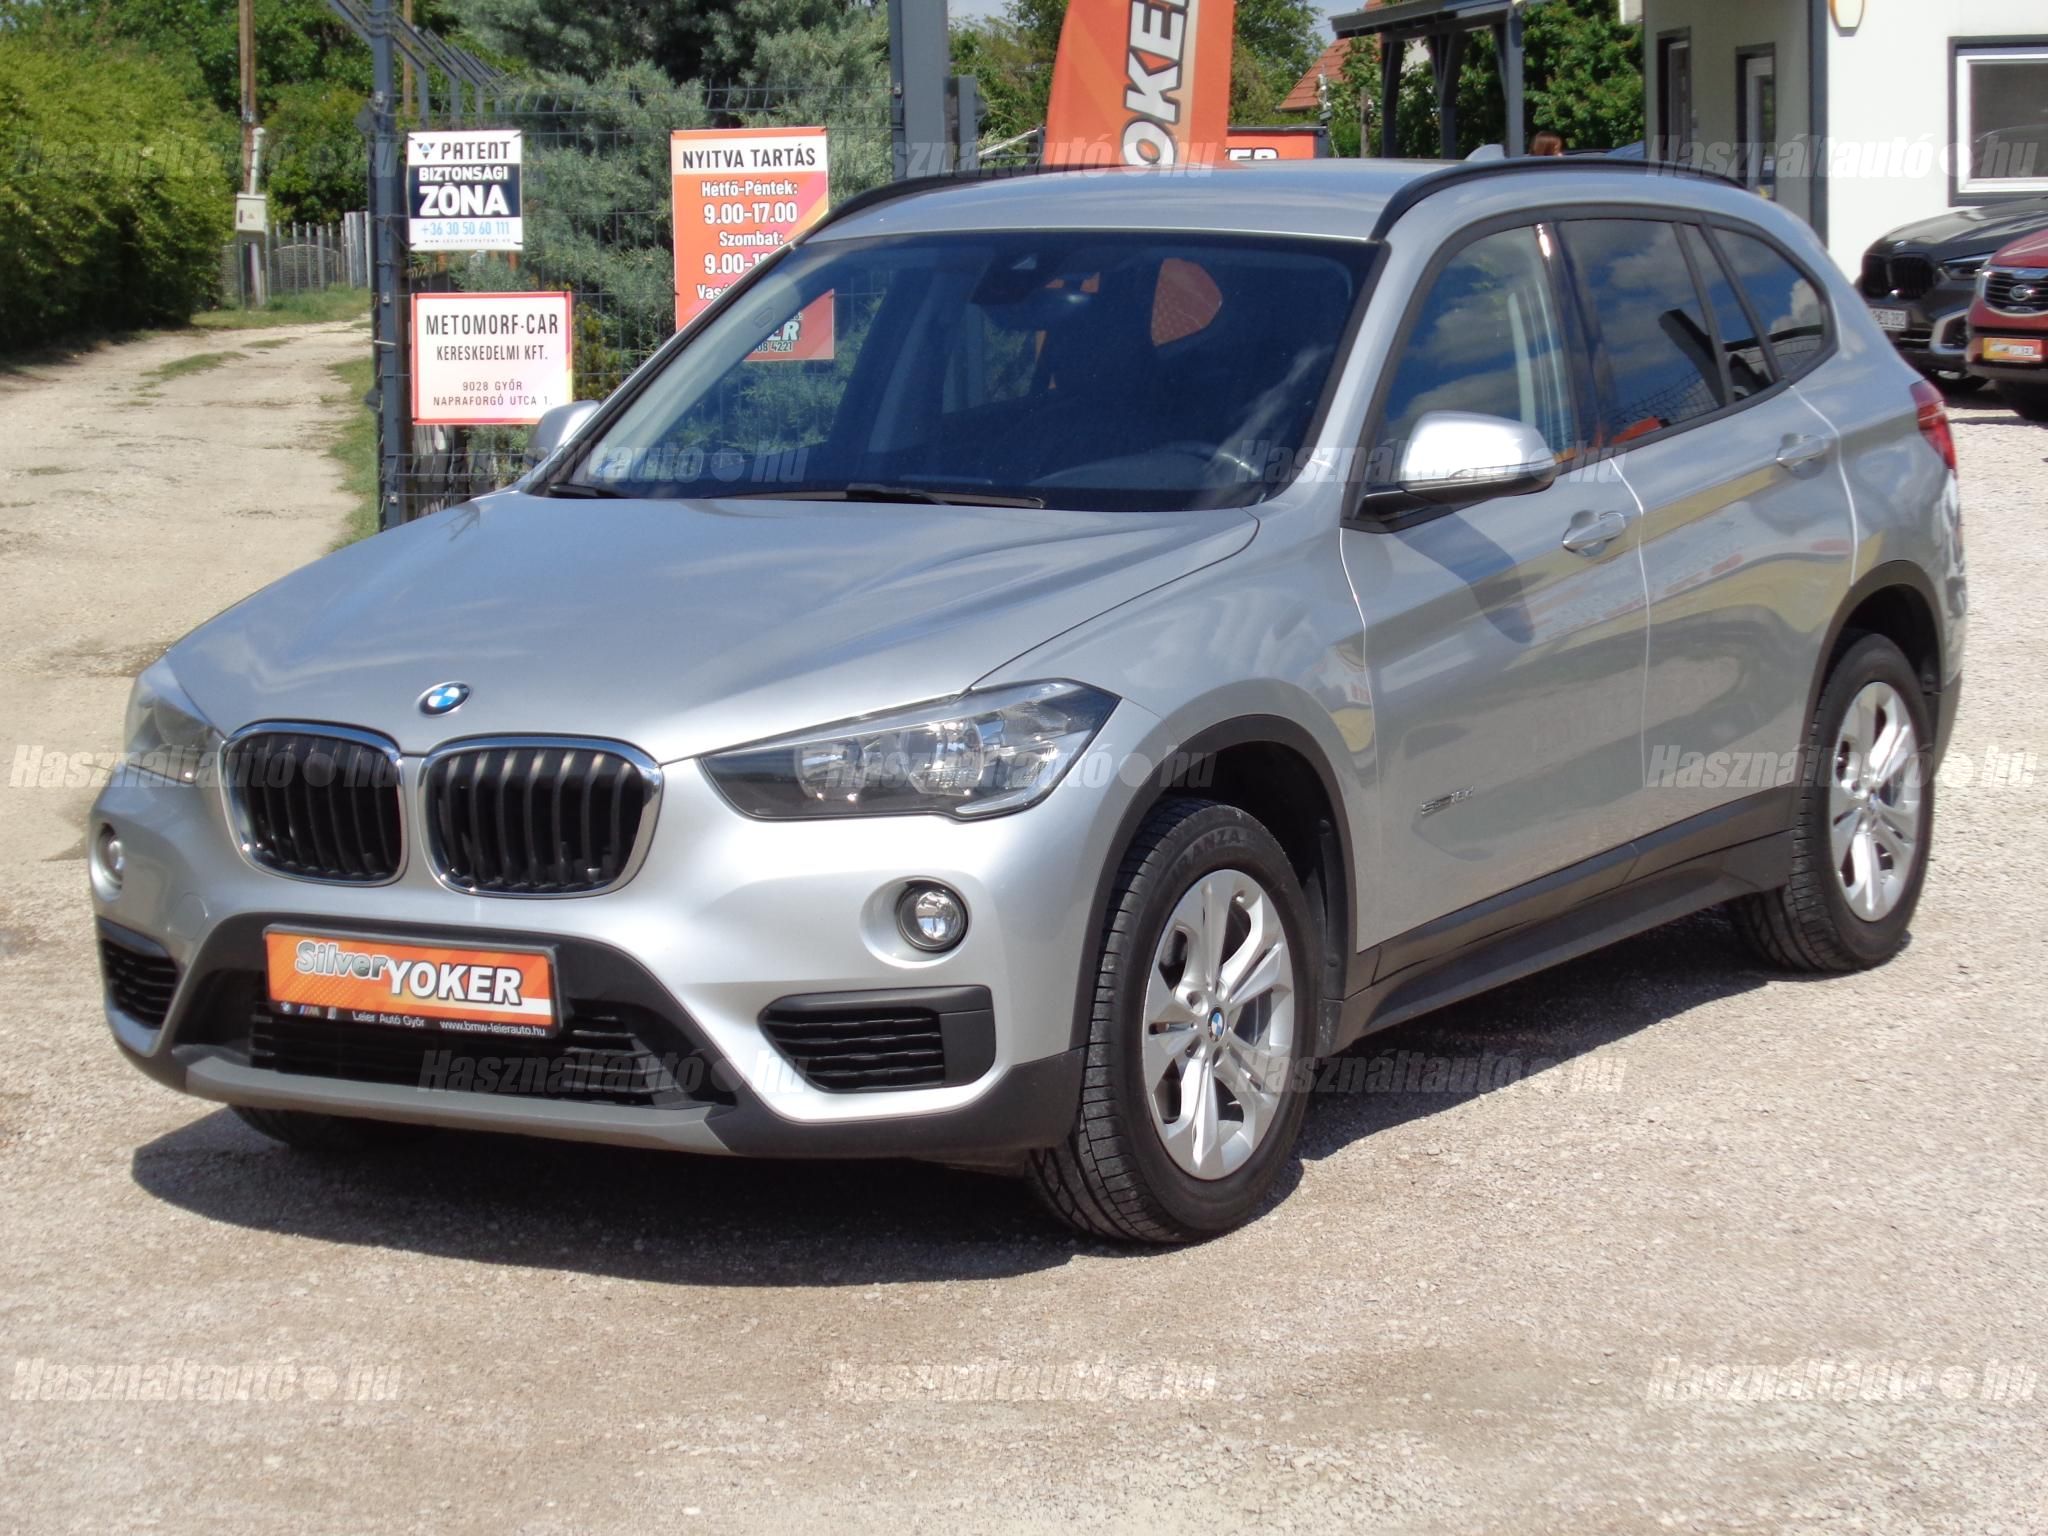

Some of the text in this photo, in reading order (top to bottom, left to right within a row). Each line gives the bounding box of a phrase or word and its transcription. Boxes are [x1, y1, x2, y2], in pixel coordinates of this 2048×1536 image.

[1123, 0, 1187, 166] OKE
[441, 141, 511, 160] PATENT
[682, 143, 816, 169] NYITVA TARTÁS
[701, 180, 798, 197] Hétfő-Péntek:
[418, 182, 511, 217] ZÓNA
[703, 202, 798, 225] 9.00-17.00
[421, 221, 511, 236] +36 30 50 60 111
[719, 231, 785, 247] Szombat:
[425, 313, 559, 335] METOMORF-CAR
[436, 345, 549, 361] KERESKEDELMI KFT.
[462, 378, 523, 391] 9028 GYŐR
[433, 394, 504, 406] NAPRAFORGÓ
[509, 395, 537, 406] UTCA
[352, 1010, 376, 1023] Leier
